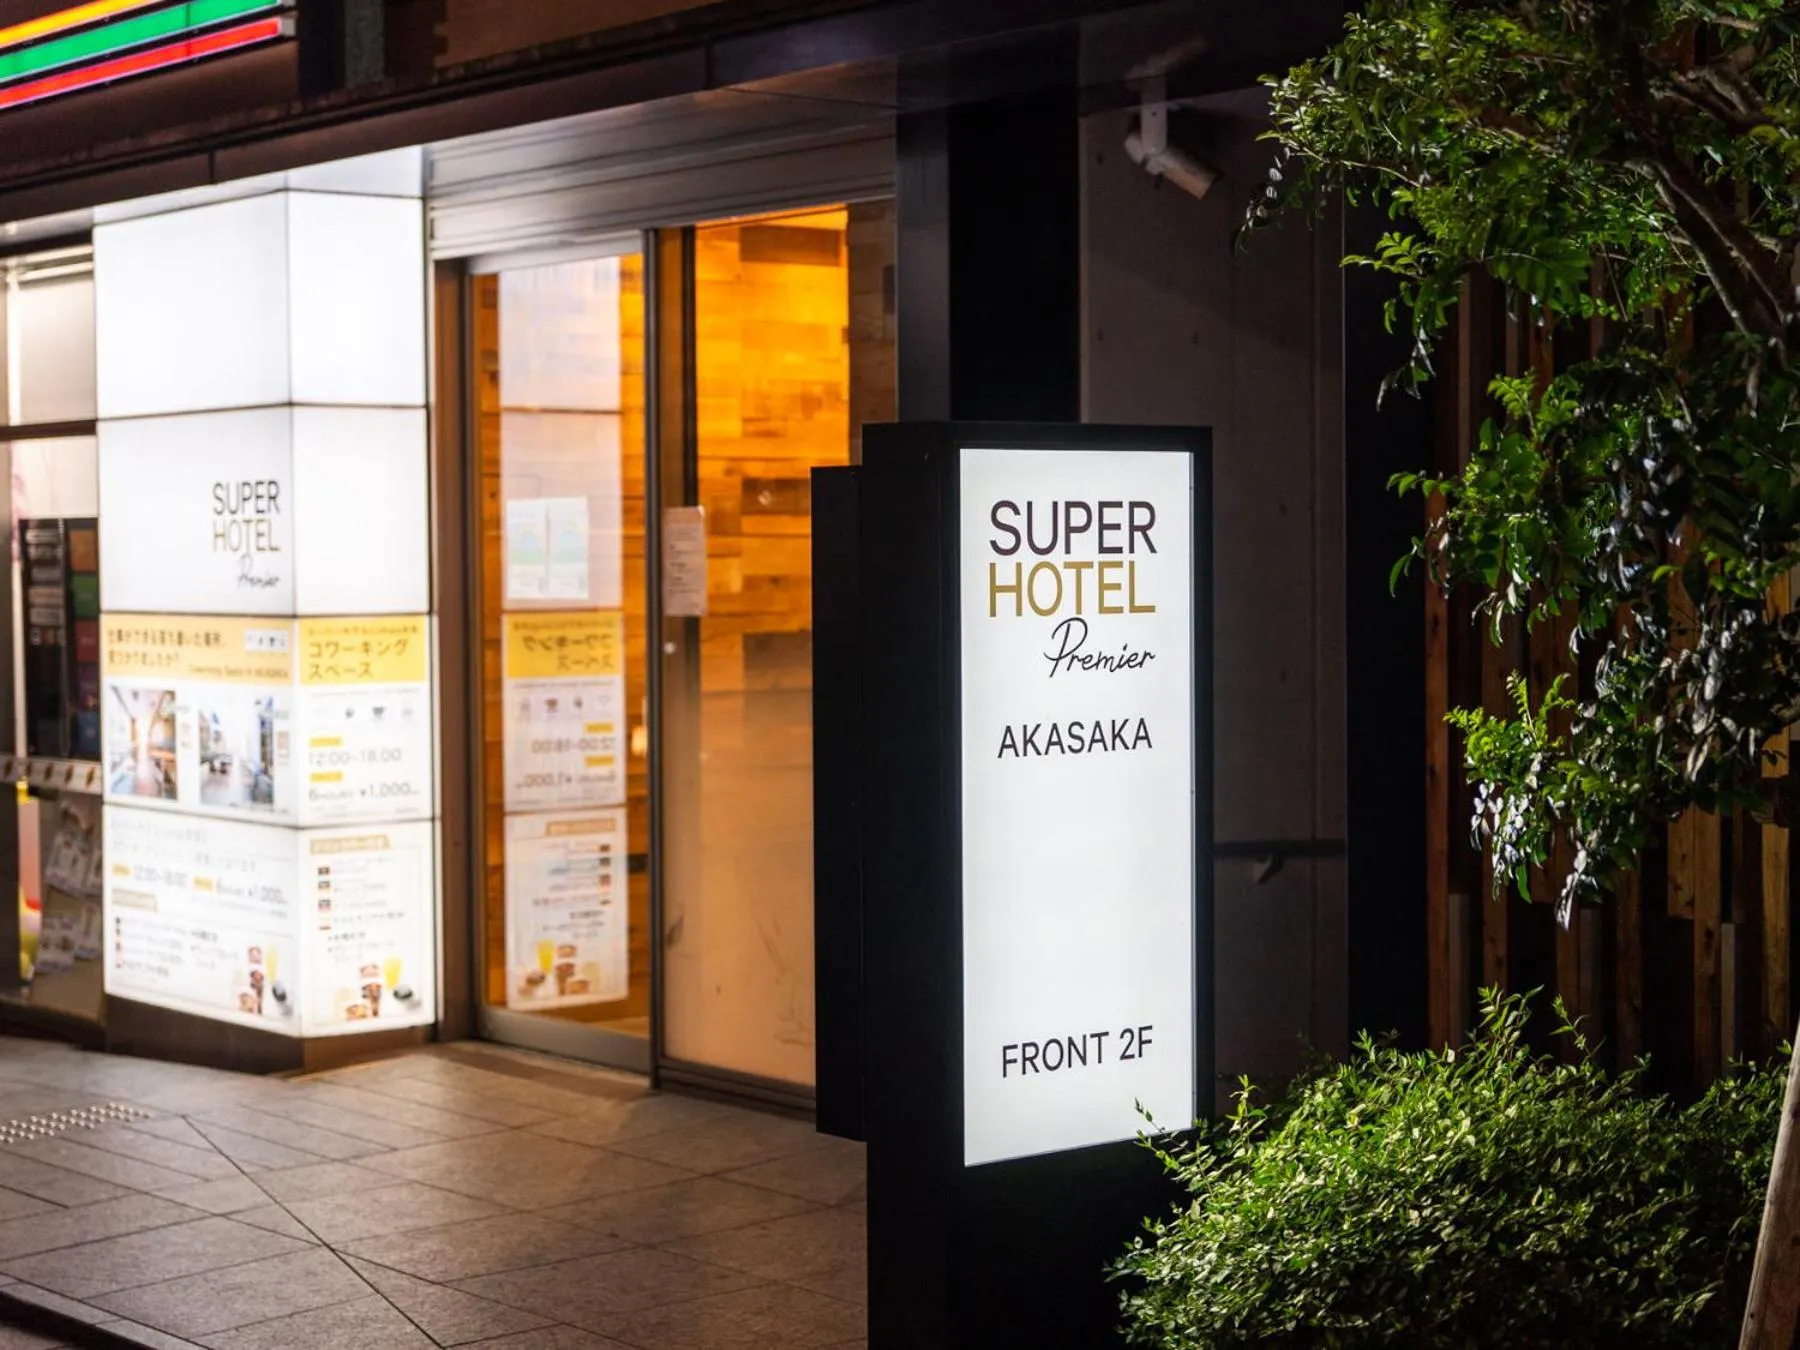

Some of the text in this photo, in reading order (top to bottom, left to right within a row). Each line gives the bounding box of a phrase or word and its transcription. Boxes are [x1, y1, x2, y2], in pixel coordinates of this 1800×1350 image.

[214, 480, 279, 515] SUPER
[214, 519, 280, 552] HOTEL
[990, 500, 1157, 556] SUPER
[990, 561, 1155, 617] HOTEL
[309, 637, 409, 659] コワーキング
[1044, 617, 1155, 678] Premier
[309, 661, 374, 680] スペース
[998, 717, 1152, 759] AKASAKA
[1003, 1025, 1152, 1078] FRONT 2F
